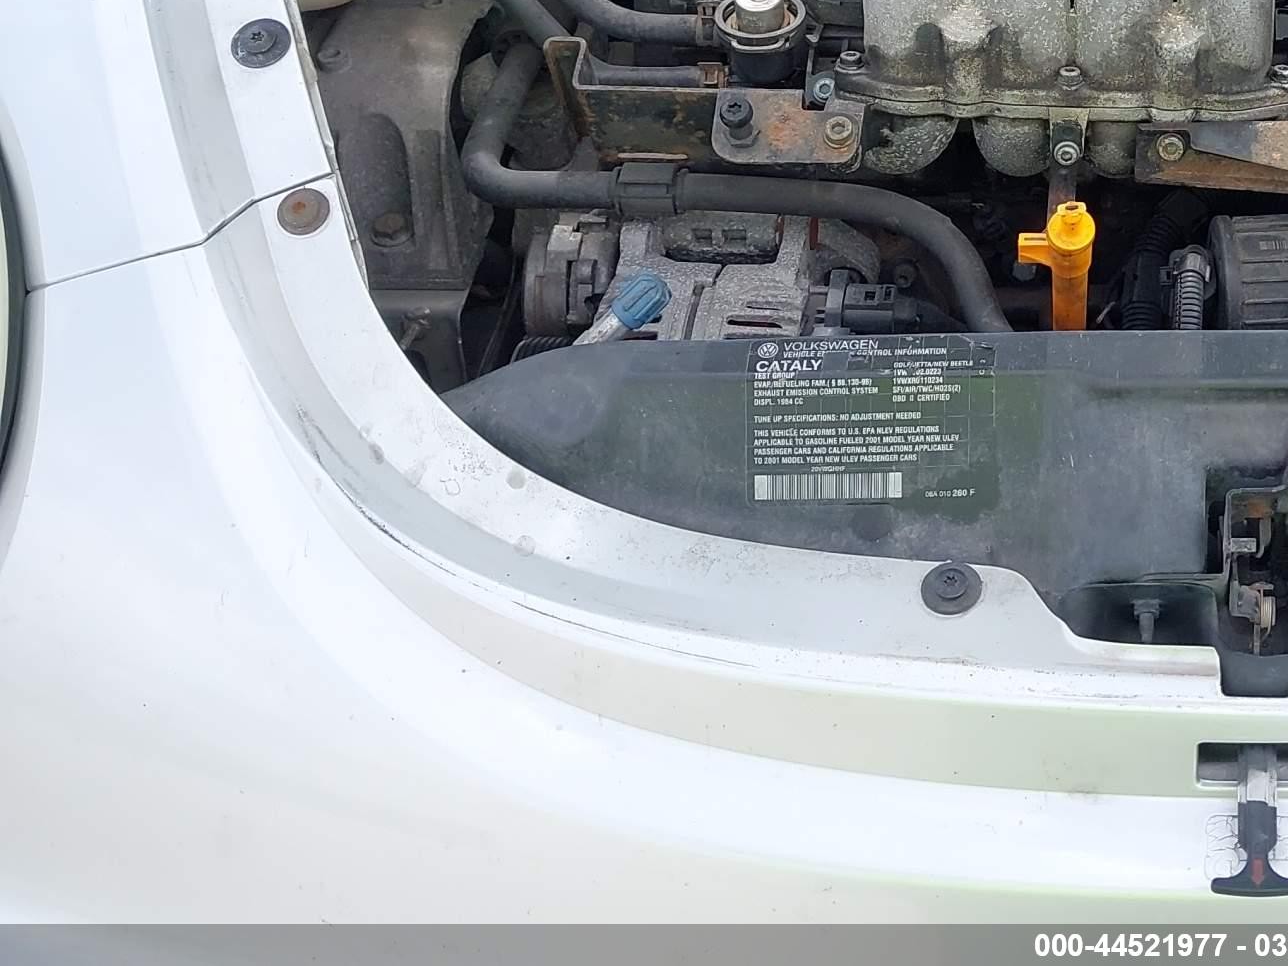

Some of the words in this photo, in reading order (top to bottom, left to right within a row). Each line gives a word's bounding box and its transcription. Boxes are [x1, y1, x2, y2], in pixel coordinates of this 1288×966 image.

[784, 340, 878, 351] VOLKSWAGEN
[756, 360, 822, 371] CATALY
[851, 412, 894, 421] ADJUSTMENT
[895, 426, 940, 434] REGULATIONS
[883, 435, 906, 443] MODEL
[828, 445, 866, 454] CALIFORNIA
